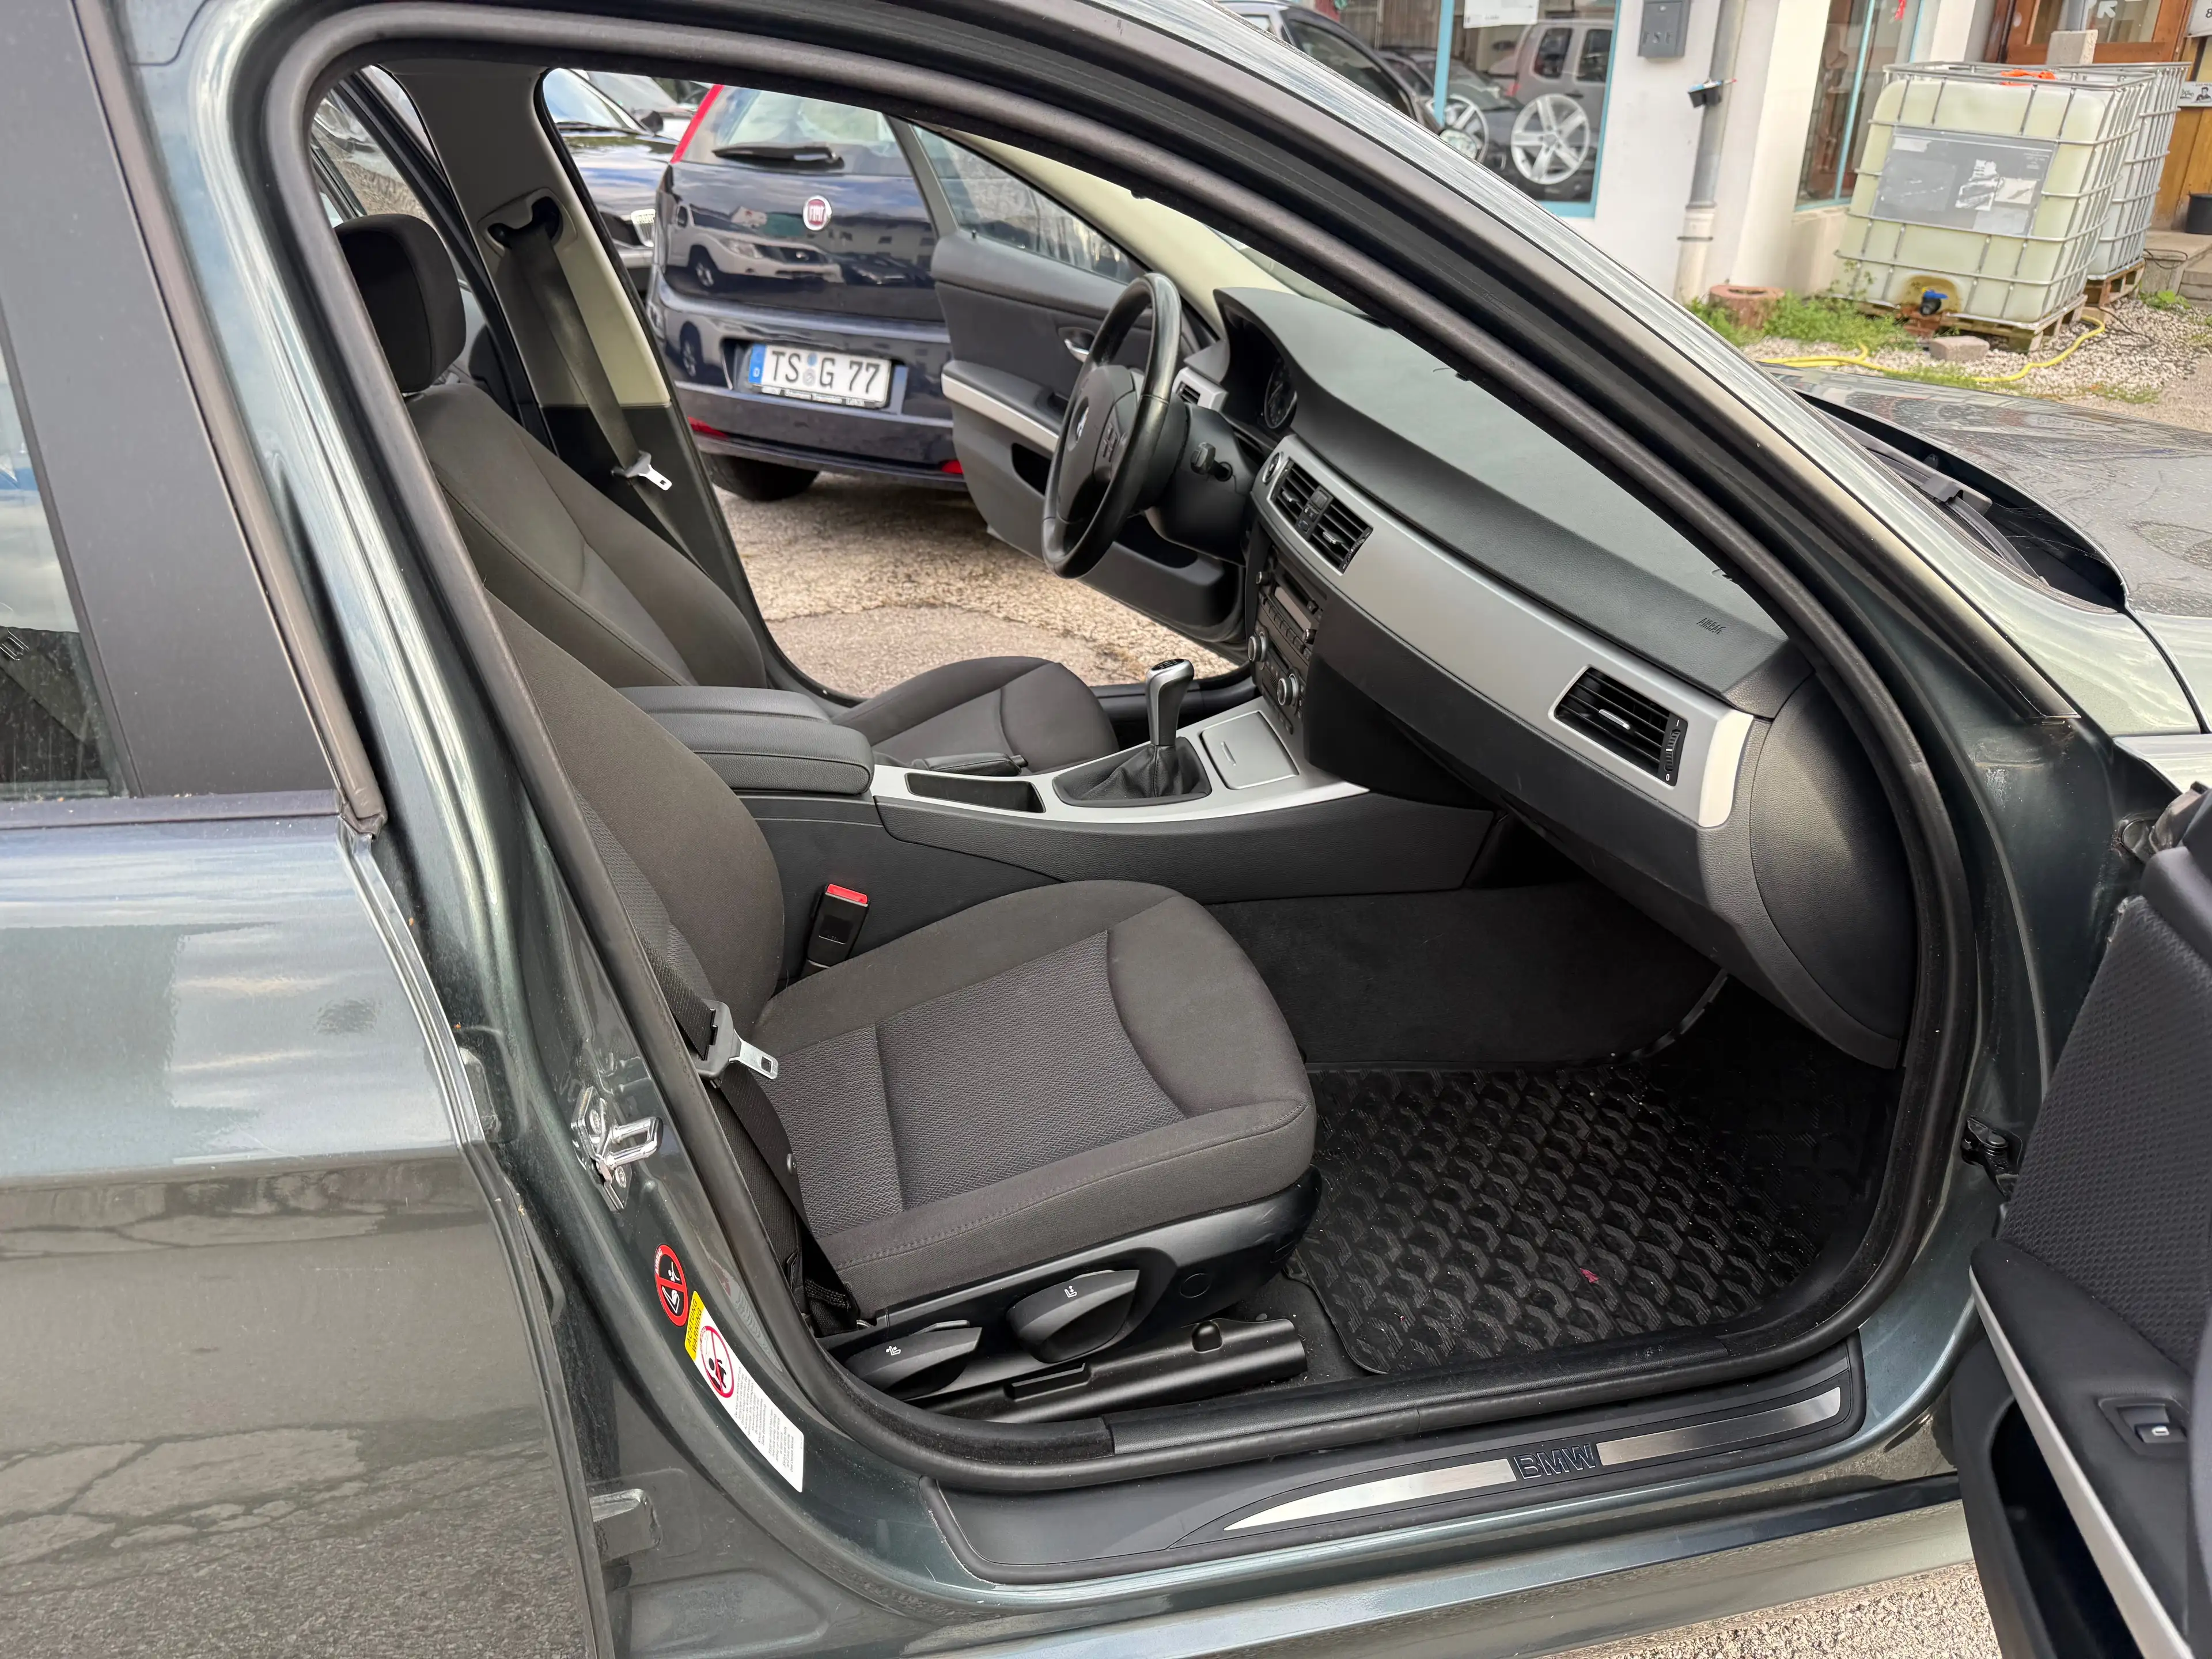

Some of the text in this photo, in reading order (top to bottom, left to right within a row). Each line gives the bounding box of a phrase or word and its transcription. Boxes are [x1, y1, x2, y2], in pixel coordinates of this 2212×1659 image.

[772, 351, 880, 393] TS G 77
[1696, 618, 1726, 634] AIRBAG
[687, 1298, 698, 1346] ACHTUNG
[692, 1308, 702, 1353] WARNING
[1513, 1444, 1596, 1479] BMW
